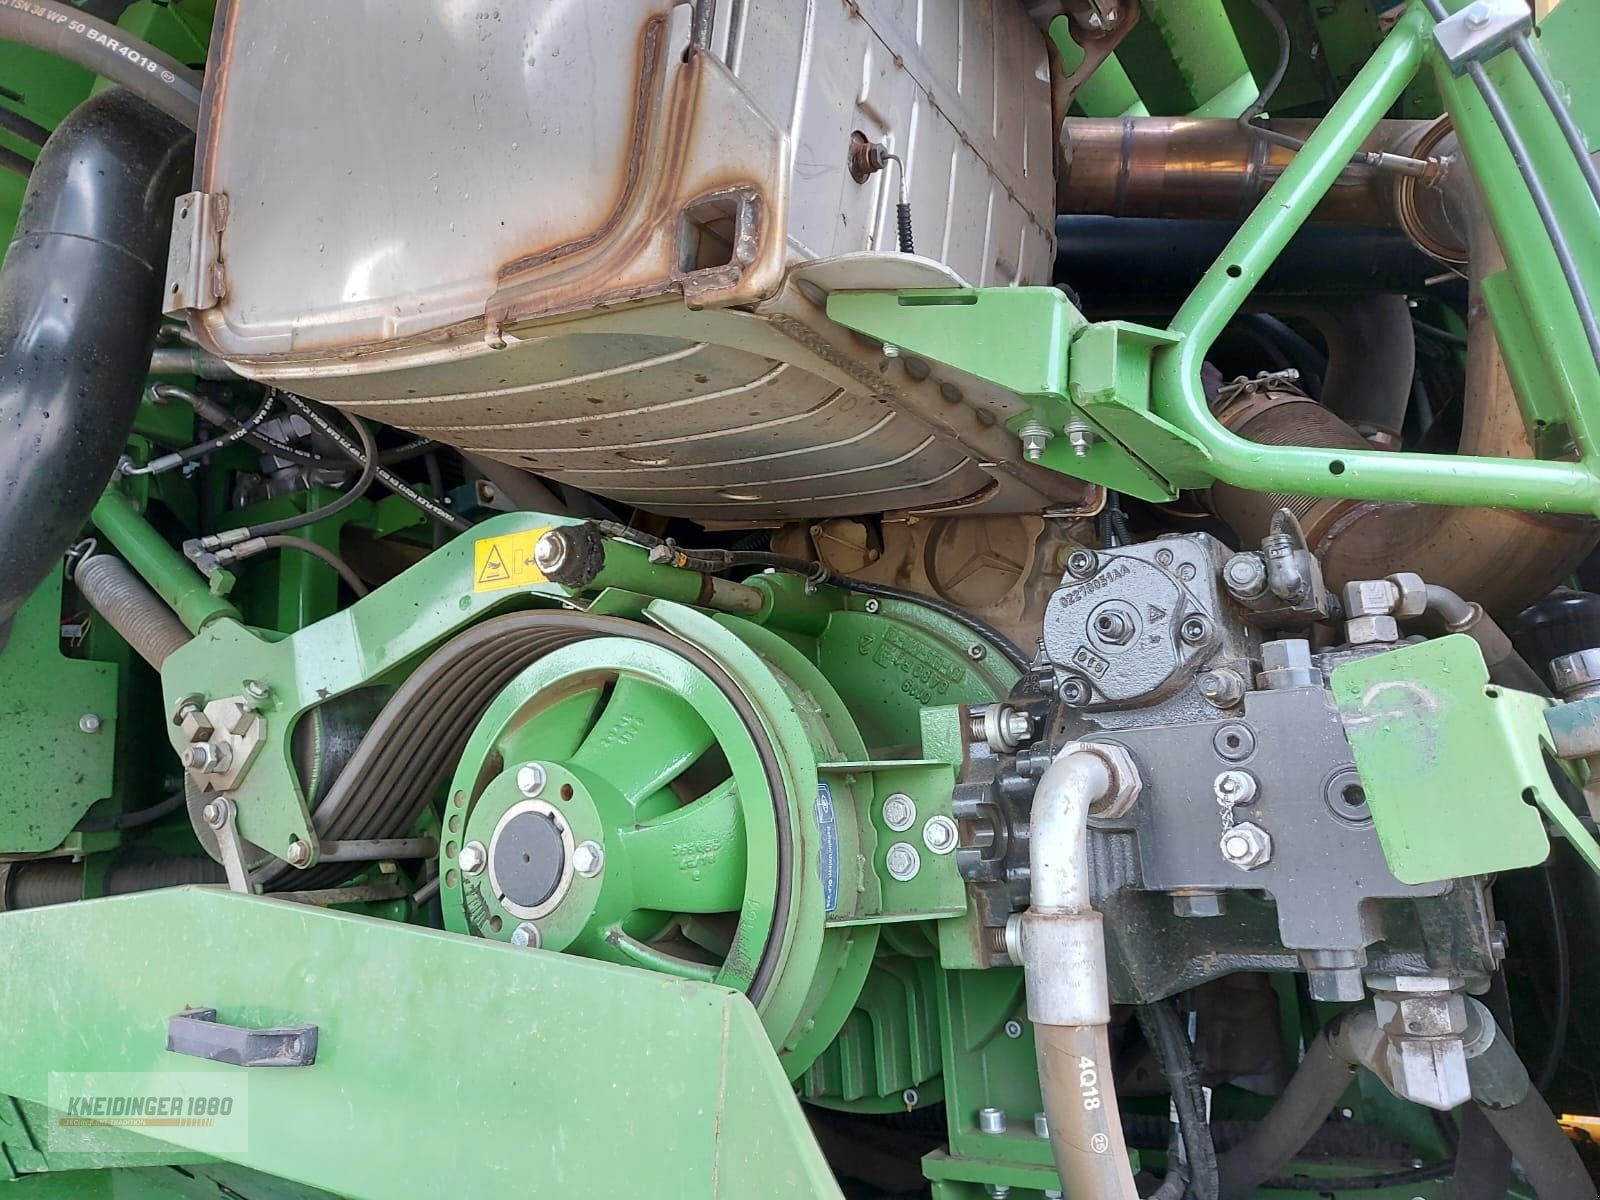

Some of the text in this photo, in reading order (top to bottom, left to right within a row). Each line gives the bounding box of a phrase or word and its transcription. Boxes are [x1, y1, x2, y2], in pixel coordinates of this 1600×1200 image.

[46, 9, 68, 24] WP
[68, 20, 86, 34] 50
[86, 28, 119, 52] BAR
[118, 46, 158, 74] 4Q18
[1079, 1056, 1100, 1110] 4Q18
